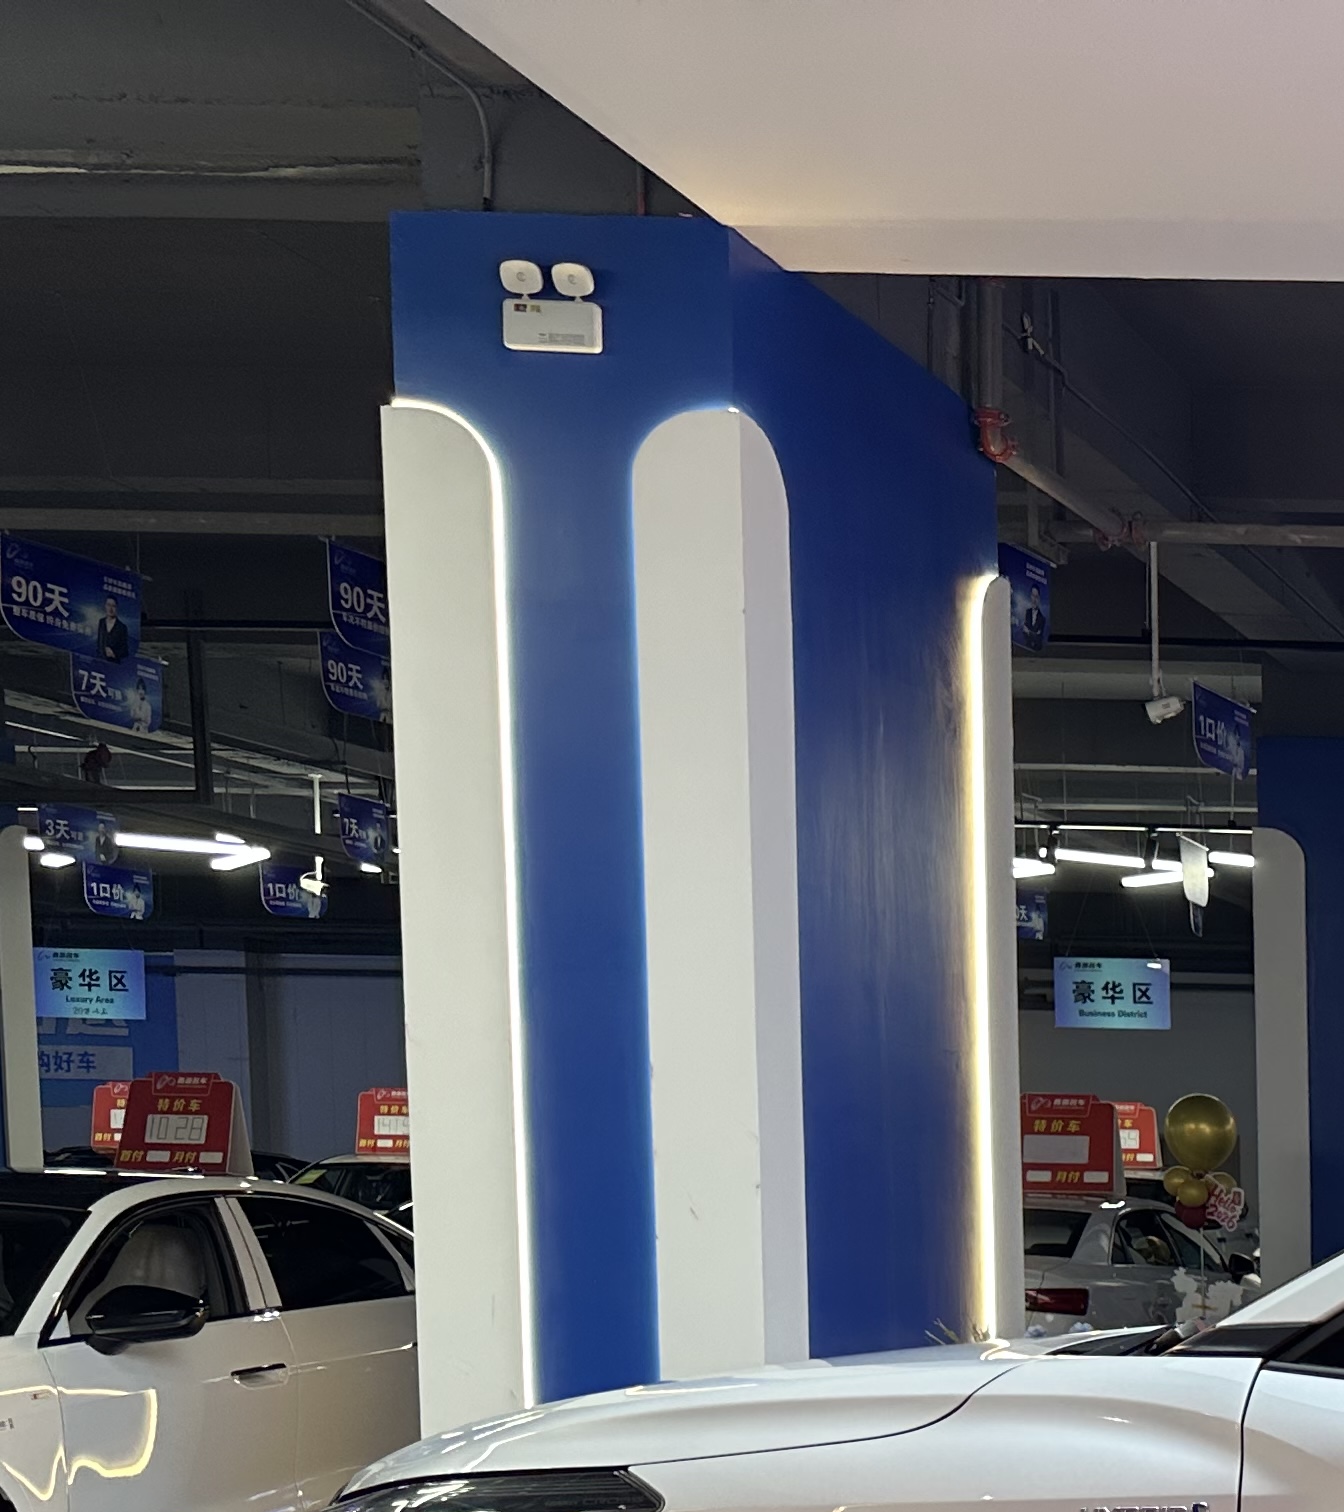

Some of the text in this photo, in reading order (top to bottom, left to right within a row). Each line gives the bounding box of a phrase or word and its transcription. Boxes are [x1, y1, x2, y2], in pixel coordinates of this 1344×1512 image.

[11, 576, 69, 618] 90天
[339, 582, 386, 624] 90天
[327, 659, 363, 690] 90天
[91, 882, 124, 901] 1口价
[267, 882, 300, 901] 1口价
[50, 967, 129, 992] 豪华区
[65, 995, 115, 1005] Luxury Area
[1072, 980, 1153, 1004] 豪华区
[1078, 1009, 1148, 1019] Business District
[157, 1098, 202, 1112] 特价车
[1033, 1119, 1081, 1133] 特价车
[120, 1150, 197, 1163] 首付 月付
[1056, 1171, 1080, 1183] 月付
